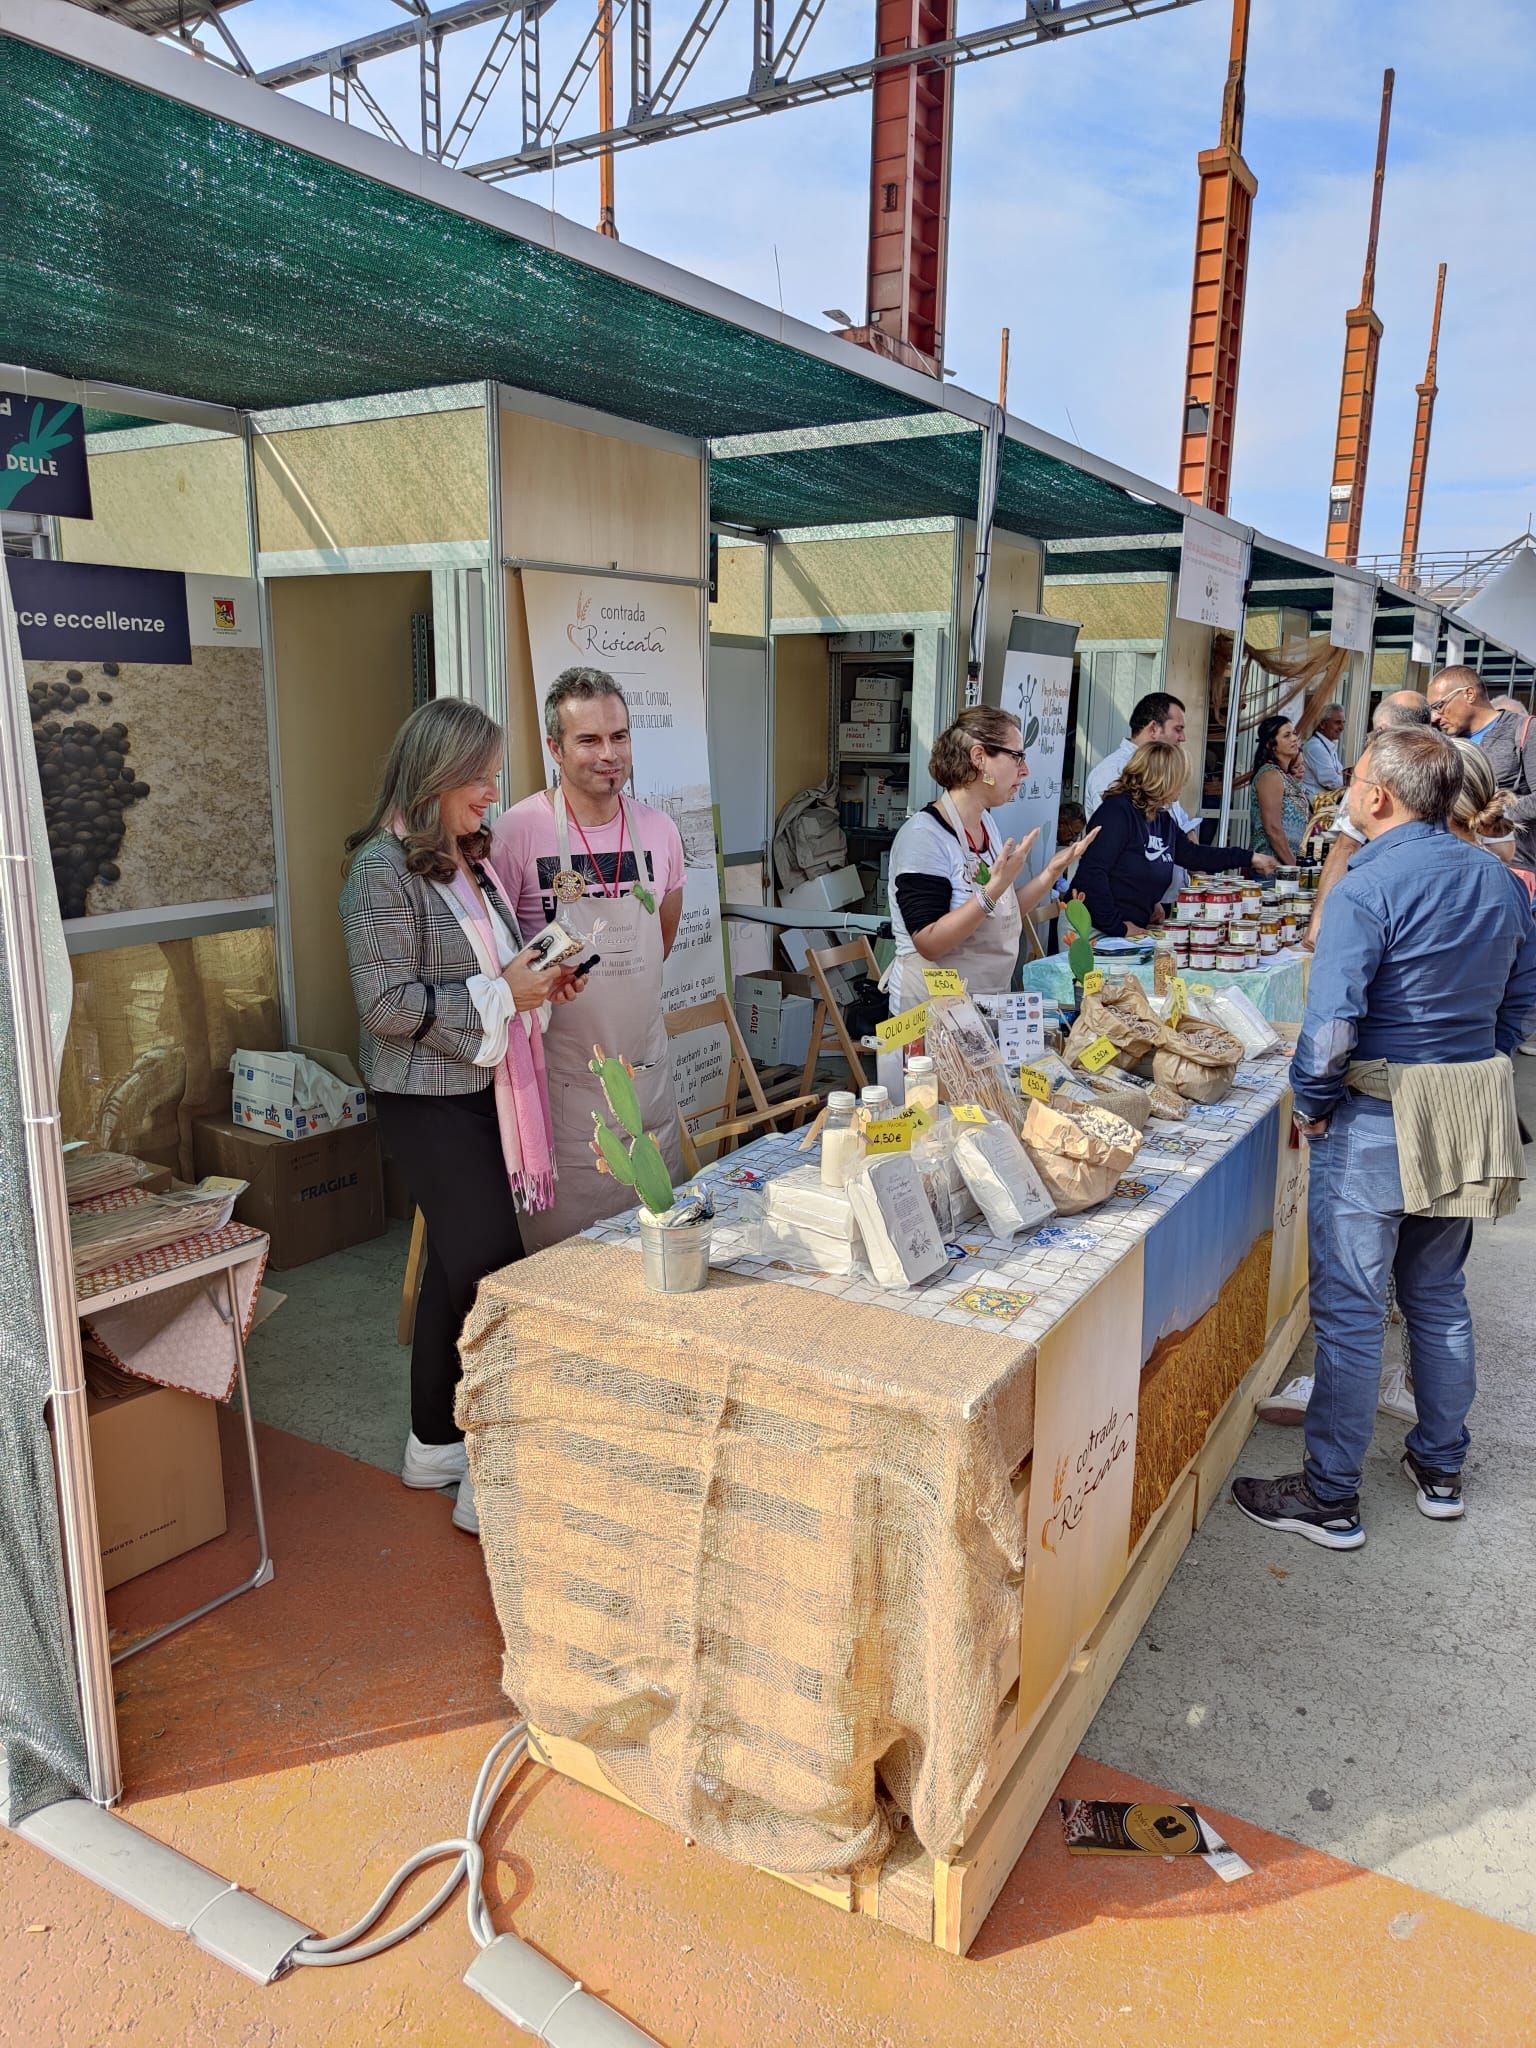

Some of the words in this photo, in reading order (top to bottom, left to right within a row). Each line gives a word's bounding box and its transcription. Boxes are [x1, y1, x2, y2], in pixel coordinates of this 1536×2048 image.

[6, 453, 58, 476] DELLE
[14, 611, 47, 627] ce
[53, 610, 166, 633] eccellenze
[600, 602, 646, 622] contrada
[577, 623, 667, 657] Risicata
[884, 1020, 903, 1040] OLIO
[301, 1172, 358, 1202] FRAGILE
[101, 1539, 134, 1557] OBUSTA
